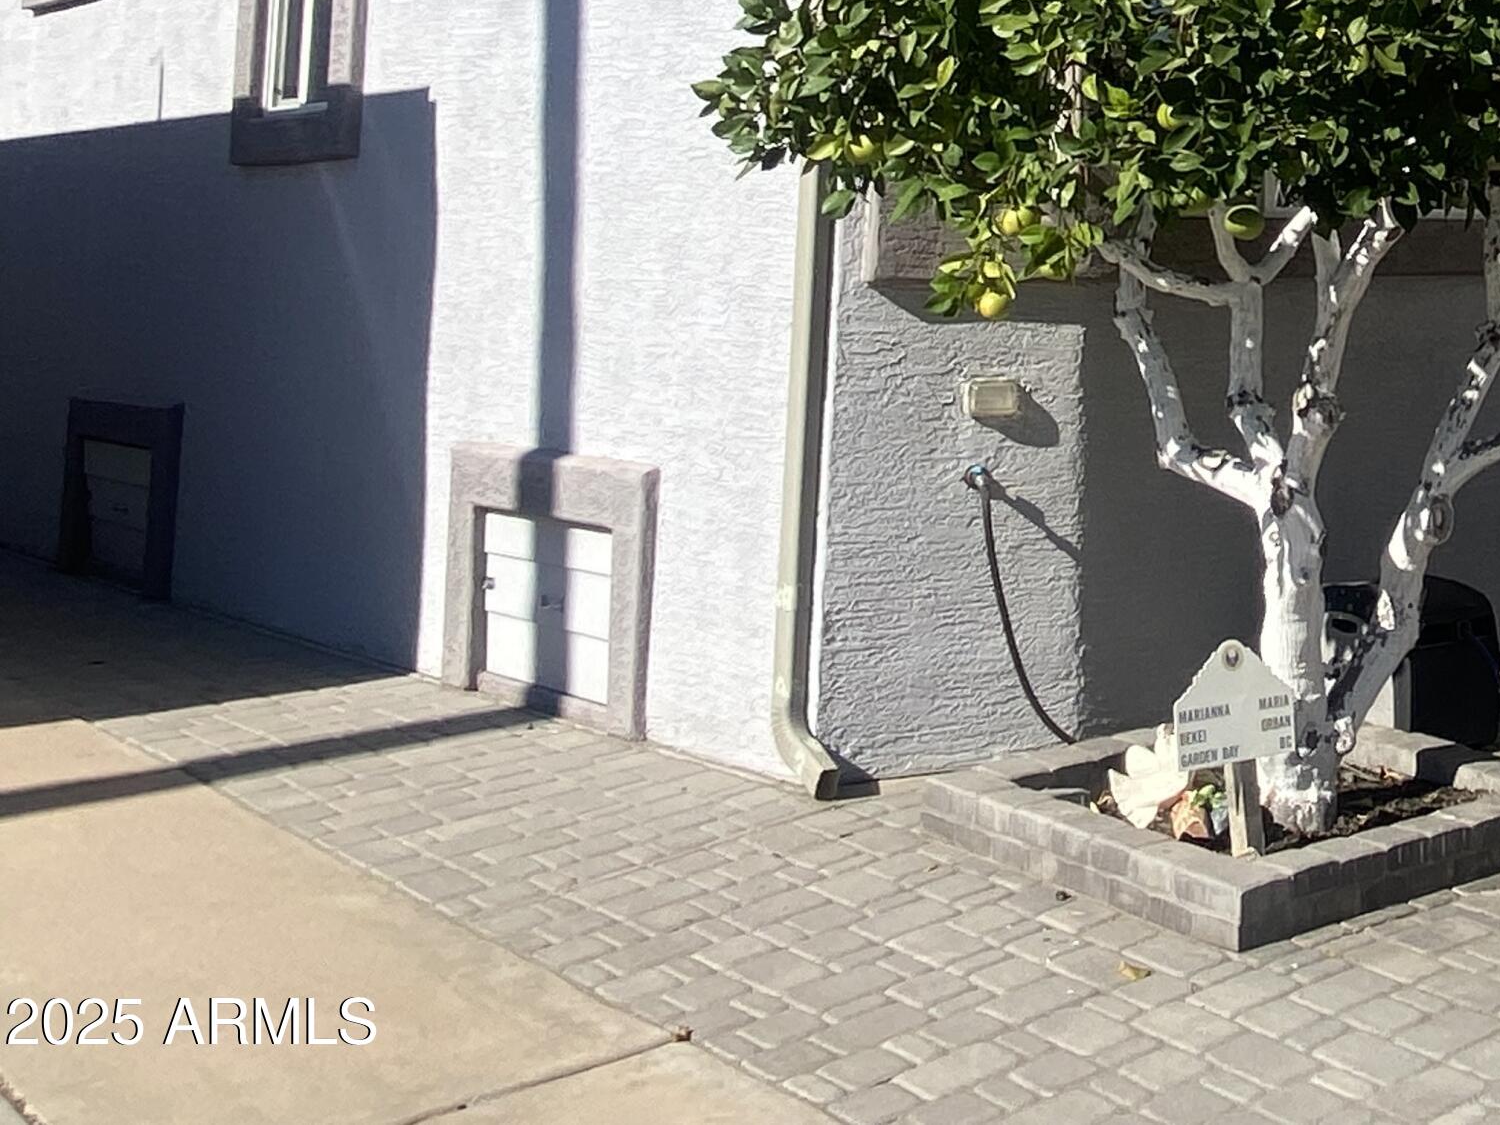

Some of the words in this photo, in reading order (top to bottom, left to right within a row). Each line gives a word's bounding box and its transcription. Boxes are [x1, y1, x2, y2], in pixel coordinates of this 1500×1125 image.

[1259, 694, 1289, 710] MARIA
[1178, 704, 1231, 724] MARIANNA
[1180, 749, 1218, 768] GARDEN
[1222, 745, 1240, 760] BAY
